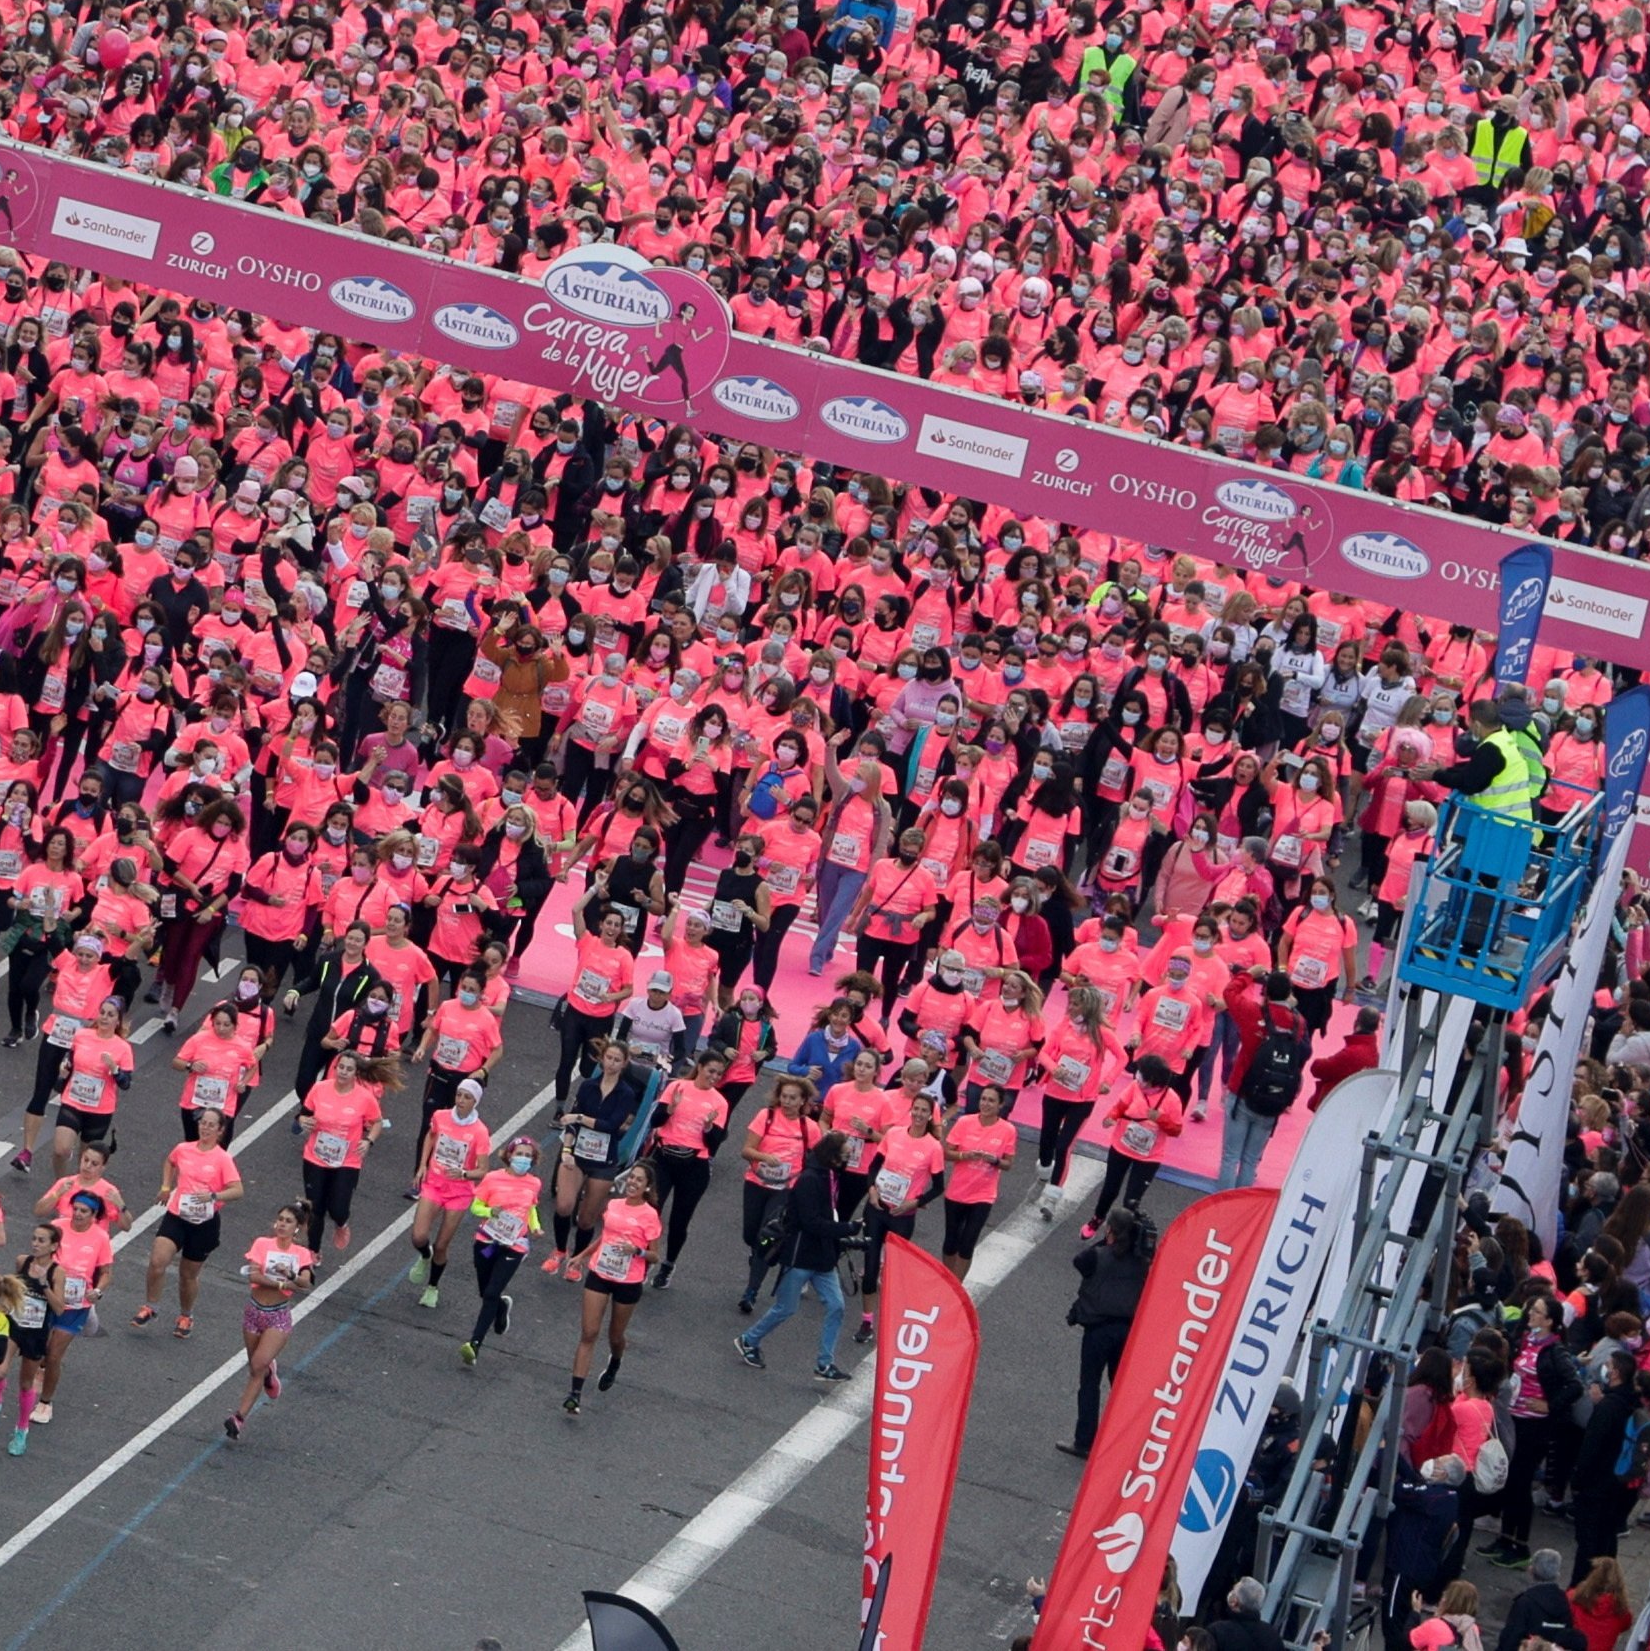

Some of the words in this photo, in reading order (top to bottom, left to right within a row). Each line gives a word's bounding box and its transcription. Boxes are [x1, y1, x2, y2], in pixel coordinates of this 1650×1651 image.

[83, 217, 147, 244] Santander
[166, 253, 227, 280] ZURICH
[237, 255, 321, 292] OYSHO
[335, 286, 407, 316] ASTURIANA
[554, 274, 659, 319] ASTURIANA
[439, 312, 511, 343] ASTURIANA
[523, 302, 629, 355] Carrera
[541, 340, 562, 361] de
[565, 344, 580, 367] la
[571, 347, 660, 402] Mujer
[719, 384, 792, 416] ASTURIANA
[826, 405, 901, 437] ASTURIANA
[948, 434, 1015, 462] Santander
[1031, 470, 1092, 497] ZURICH
[1109, 473, 1197, 511] OYSHO
[1221, 487, 1290, 517] ASTURIANA
[1202, 506, 1268, 538] Carrera
[1214, 530, 1227, 544] de
[1228, 535, 1239, 548] la
[1234, 537, 1290, 569] Mujer
[1347, 541, 1423, 574] ASTURIANA
[1567, 594, 1634, 622] Santander
[1216, 1192, 1327, 1427] ZURICH
[1121, 1228, 1234, 1503] Santander
